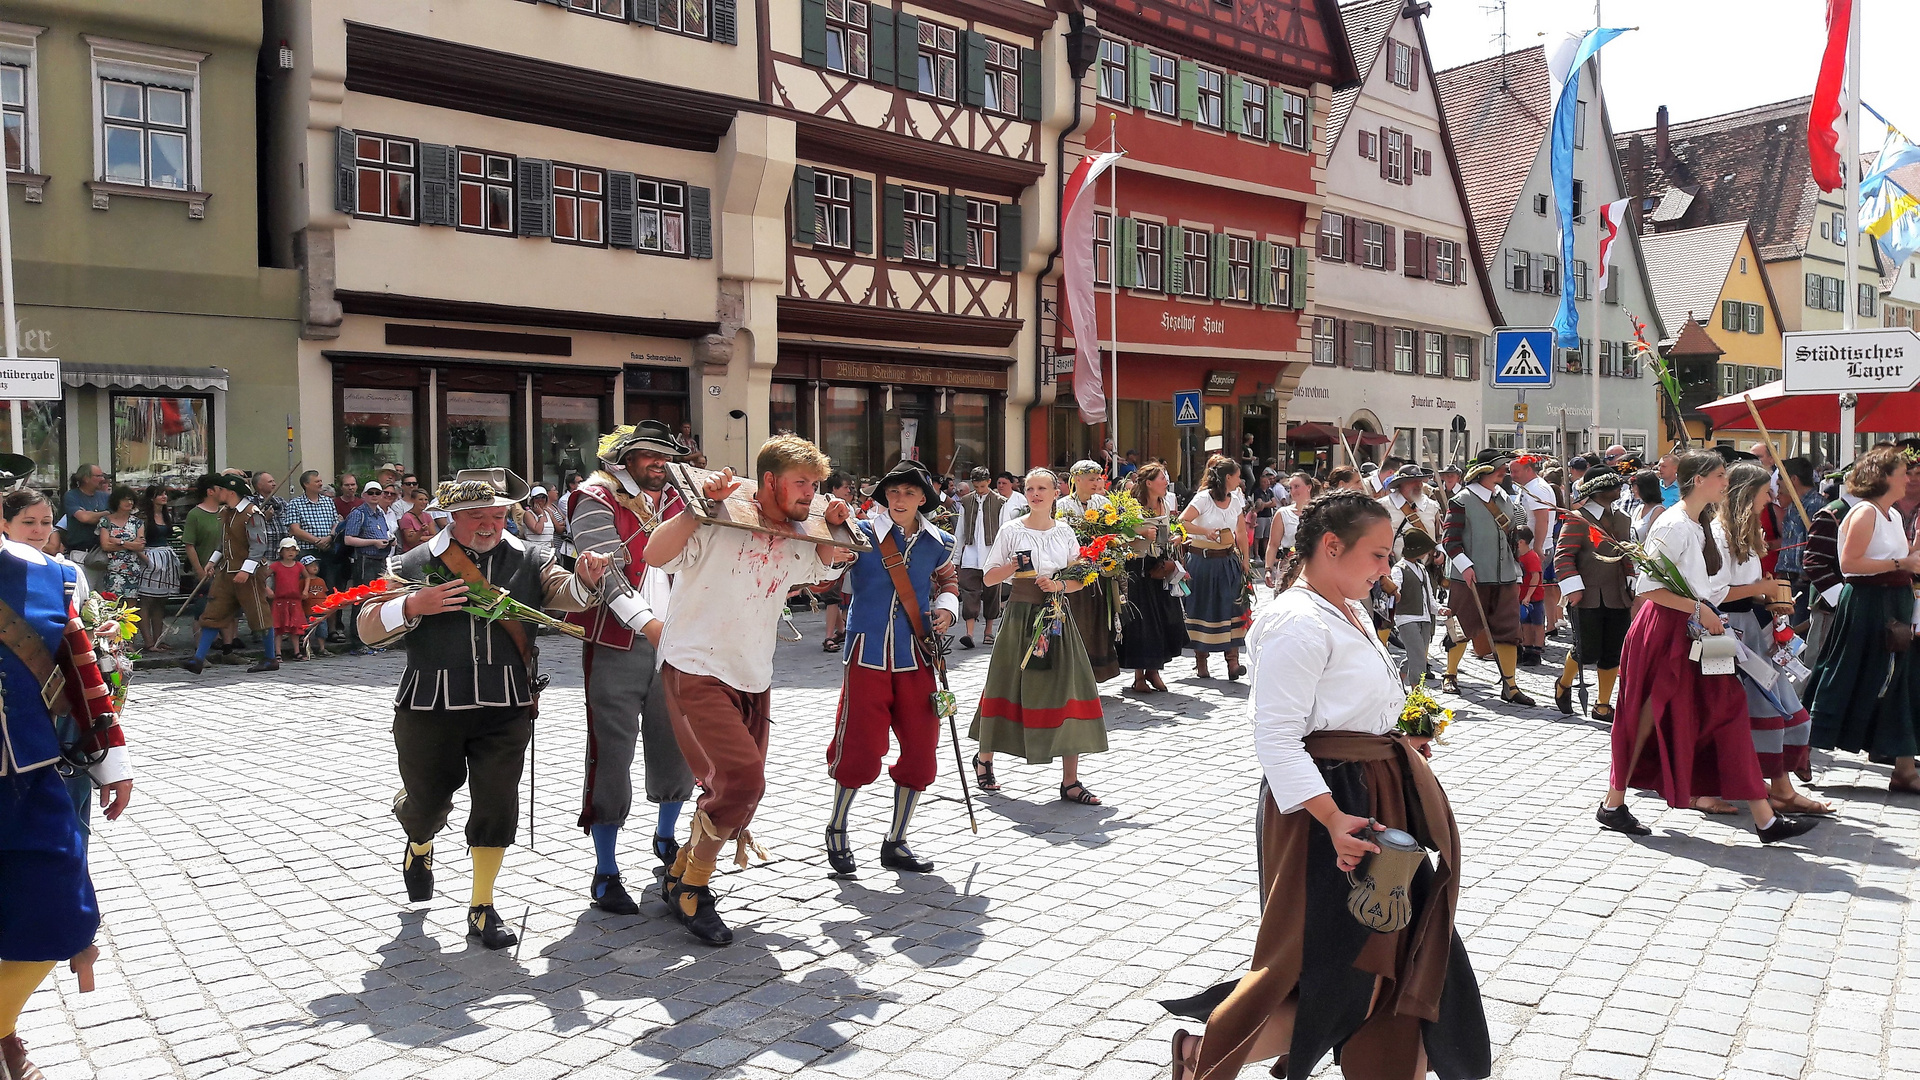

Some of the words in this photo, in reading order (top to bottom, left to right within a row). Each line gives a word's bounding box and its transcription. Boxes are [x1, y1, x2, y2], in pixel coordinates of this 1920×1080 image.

[1161, 311, 1196, 333] Hezelhof
[1203, 317, 1226, 335] Hotel
[1795, 344, 1904, 363] Städtisches
[0, 369, 55, 381] tübergabe
[1847, 361, 1904, 380] Lager
